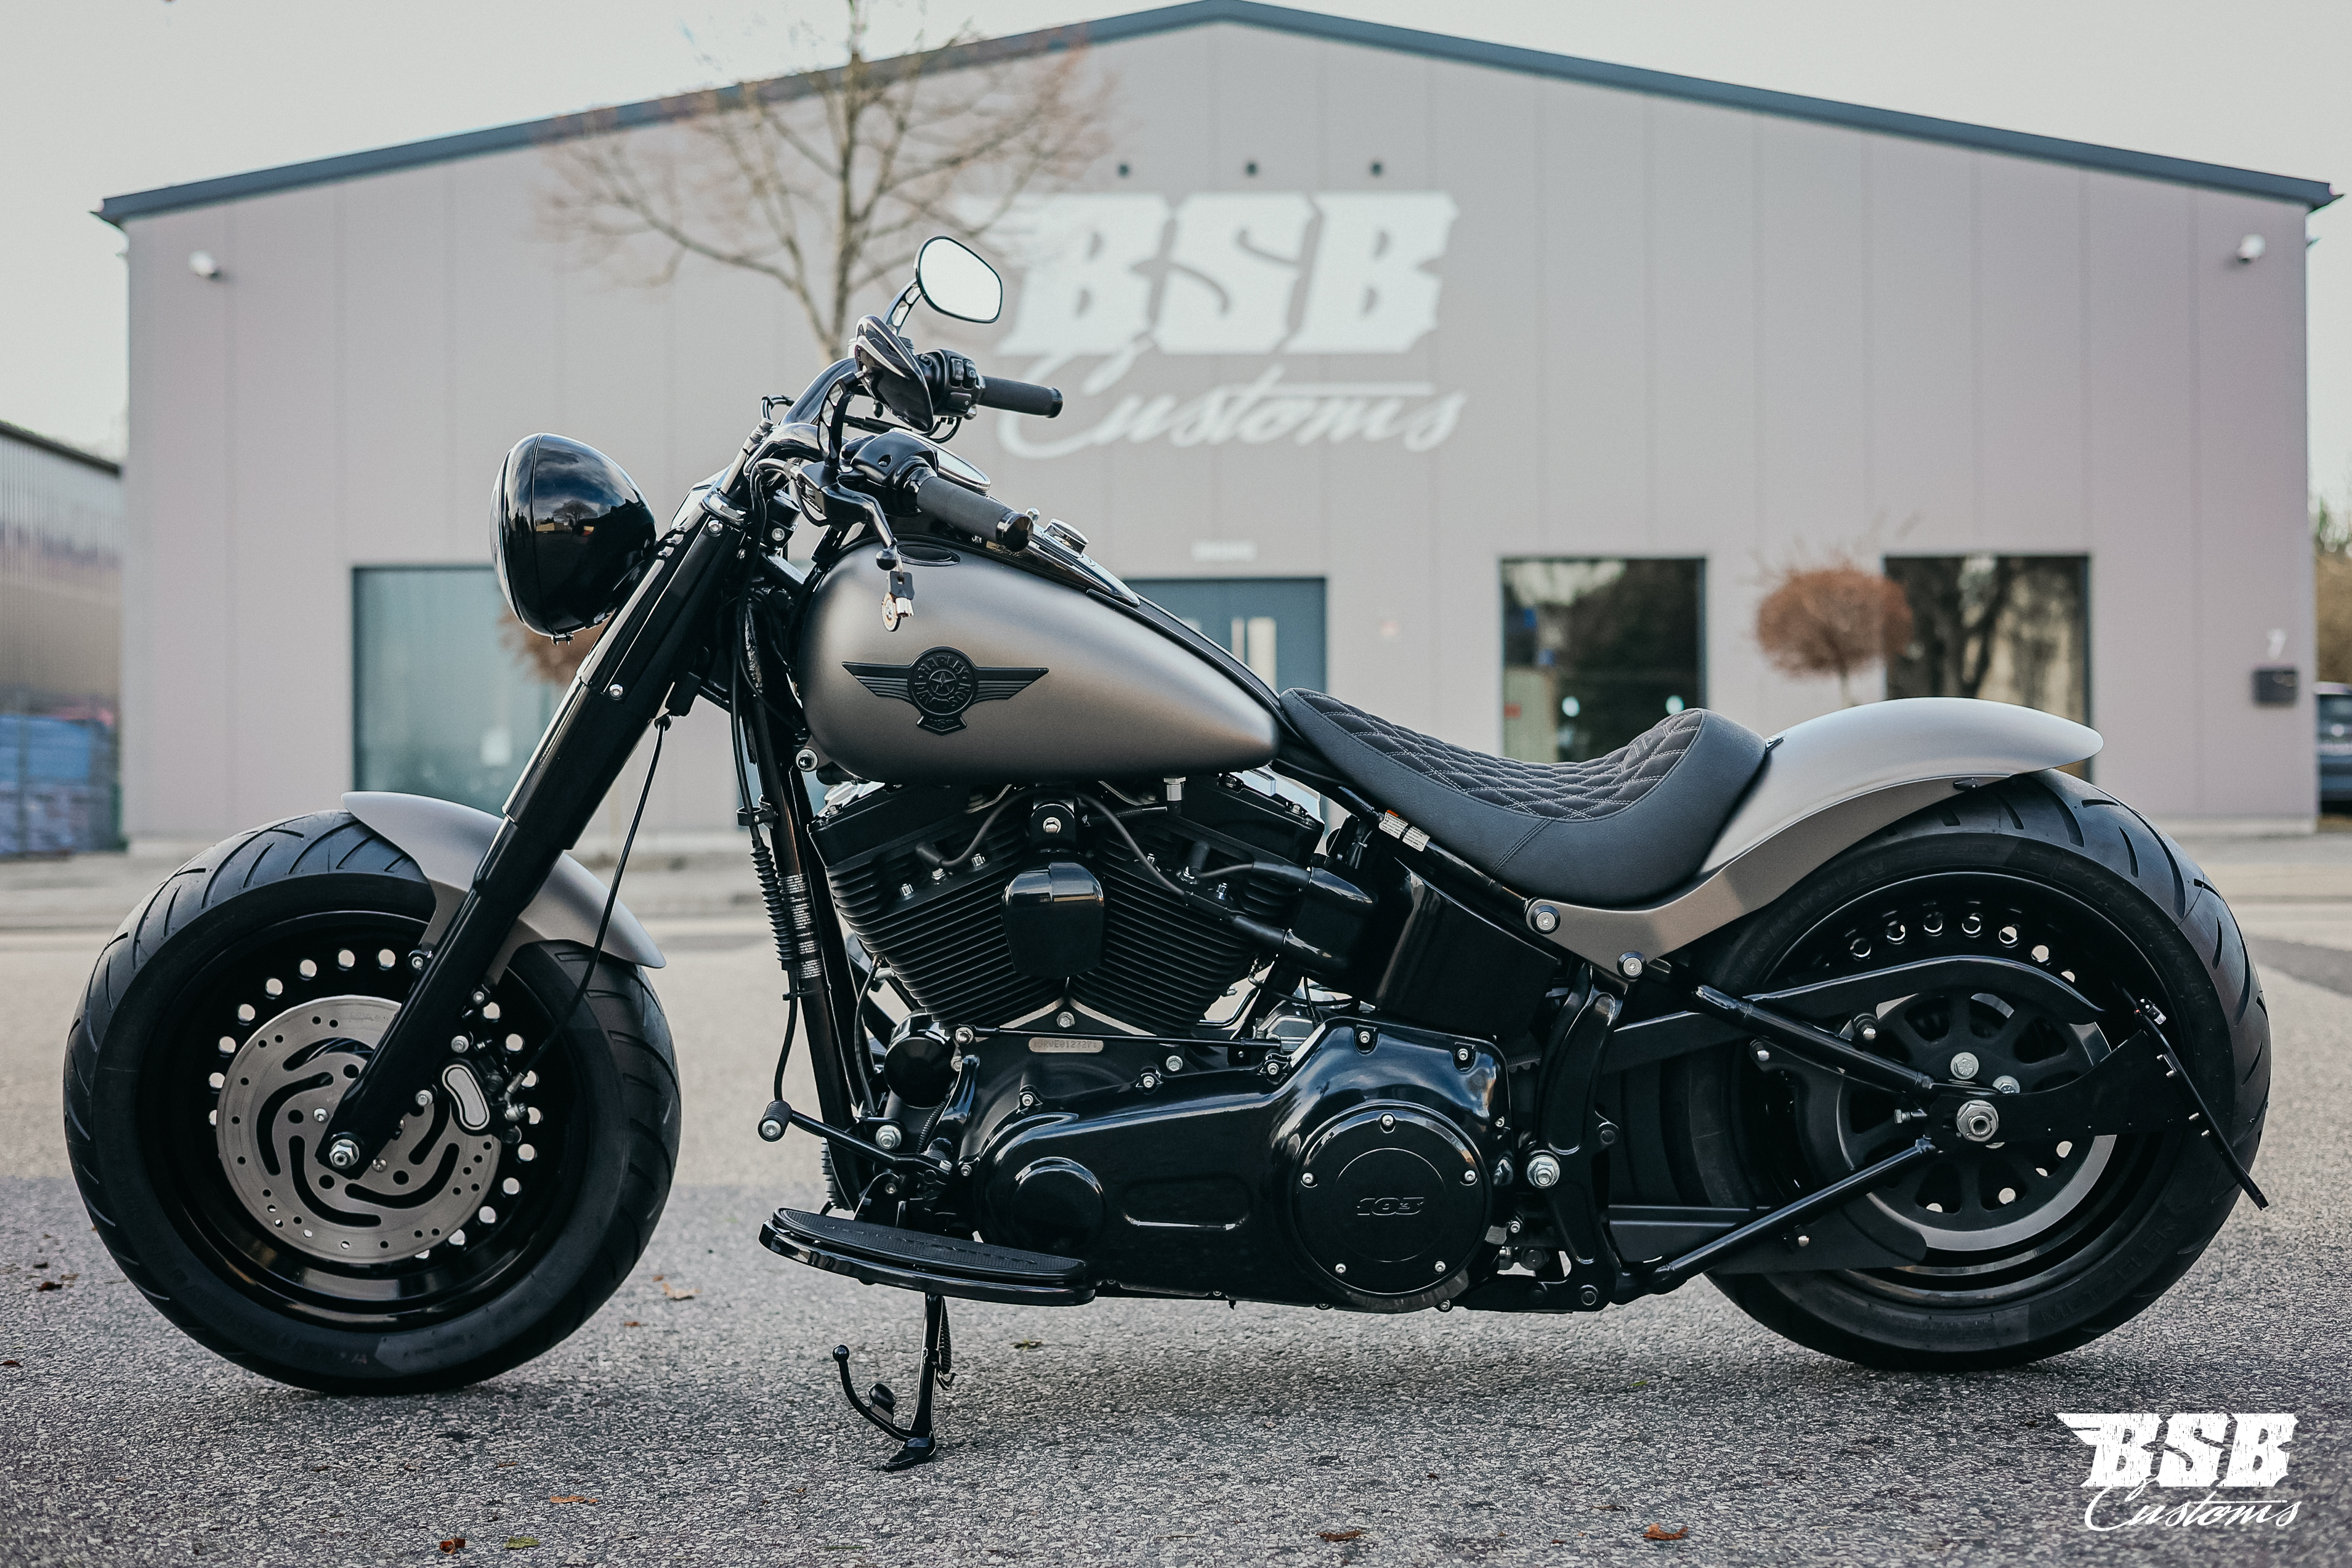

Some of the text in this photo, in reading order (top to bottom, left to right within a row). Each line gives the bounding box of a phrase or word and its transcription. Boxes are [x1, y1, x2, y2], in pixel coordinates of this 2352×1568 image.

[953, 192, 1460, 355] BSB
[996, 329, 1467, 459] Customs
[918, 655, 970, 675] HARLEY
[914, 682, 972, 708] DAVSON
[1357, 1197, 1424, 1216] 103
